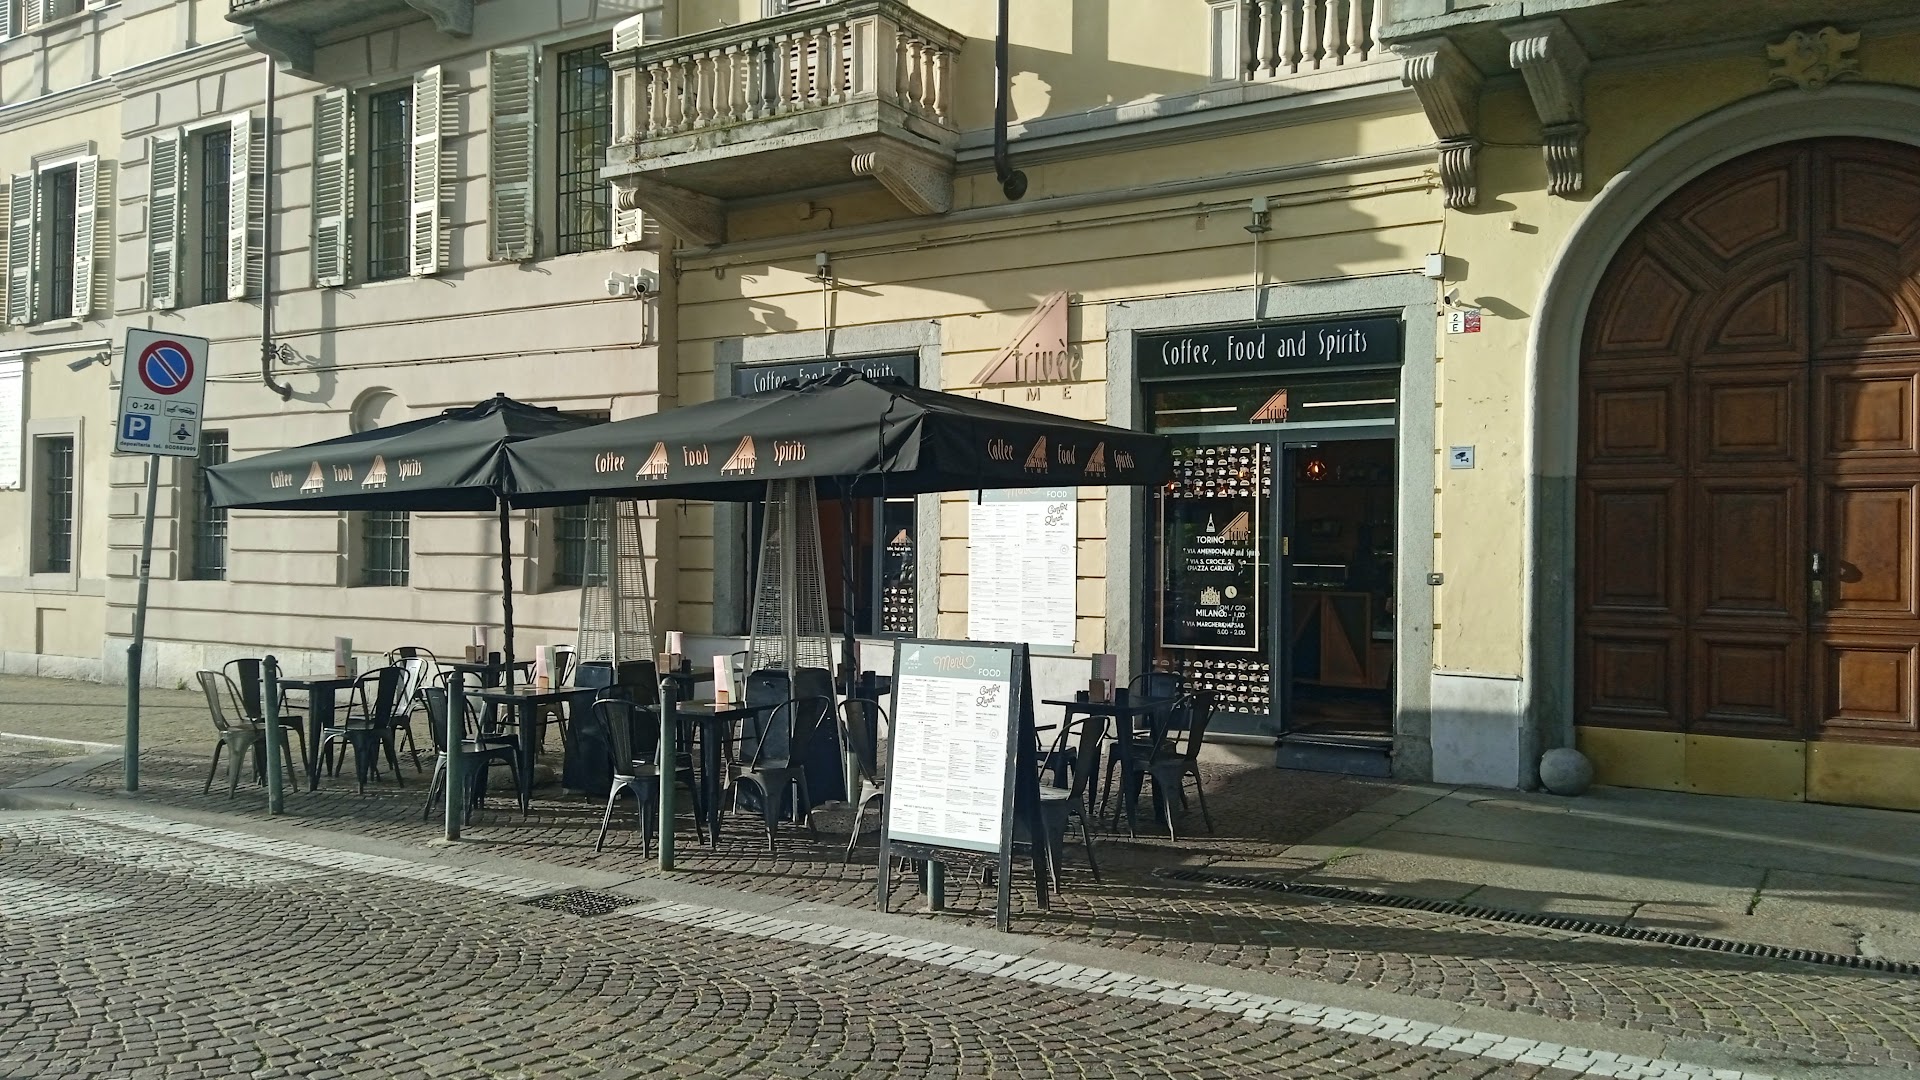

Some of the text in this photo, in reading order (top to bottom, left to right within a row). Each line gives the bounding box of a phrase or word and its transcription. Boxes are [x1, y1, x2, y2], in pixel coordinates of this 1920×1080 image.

[1452, 313, 1459, 322] 2
[1452, 323, 1459, 332] E
[1161, 329, 1368, 366] Coffee, Food and Spirits
[971, 386, 1072, 403] TIME
[128, 417, 146, 437] P
[595, 440, 806, 473] Coffee Food Spirits
[987, 438, 1135, 472] Coffee Food Spirits
[270, 458, 422, 489] Coffee Food Spirits
[635, 473, 668, 481] TIME
[720, 468, 755, 477] TIME
[1046, 490, 1068, 498] FOOD
[1196, 535, 1226, 544] TORINO
[1195, 608, 1225, 617] MILANO
[978, 668, 1001, 677] FOOD
